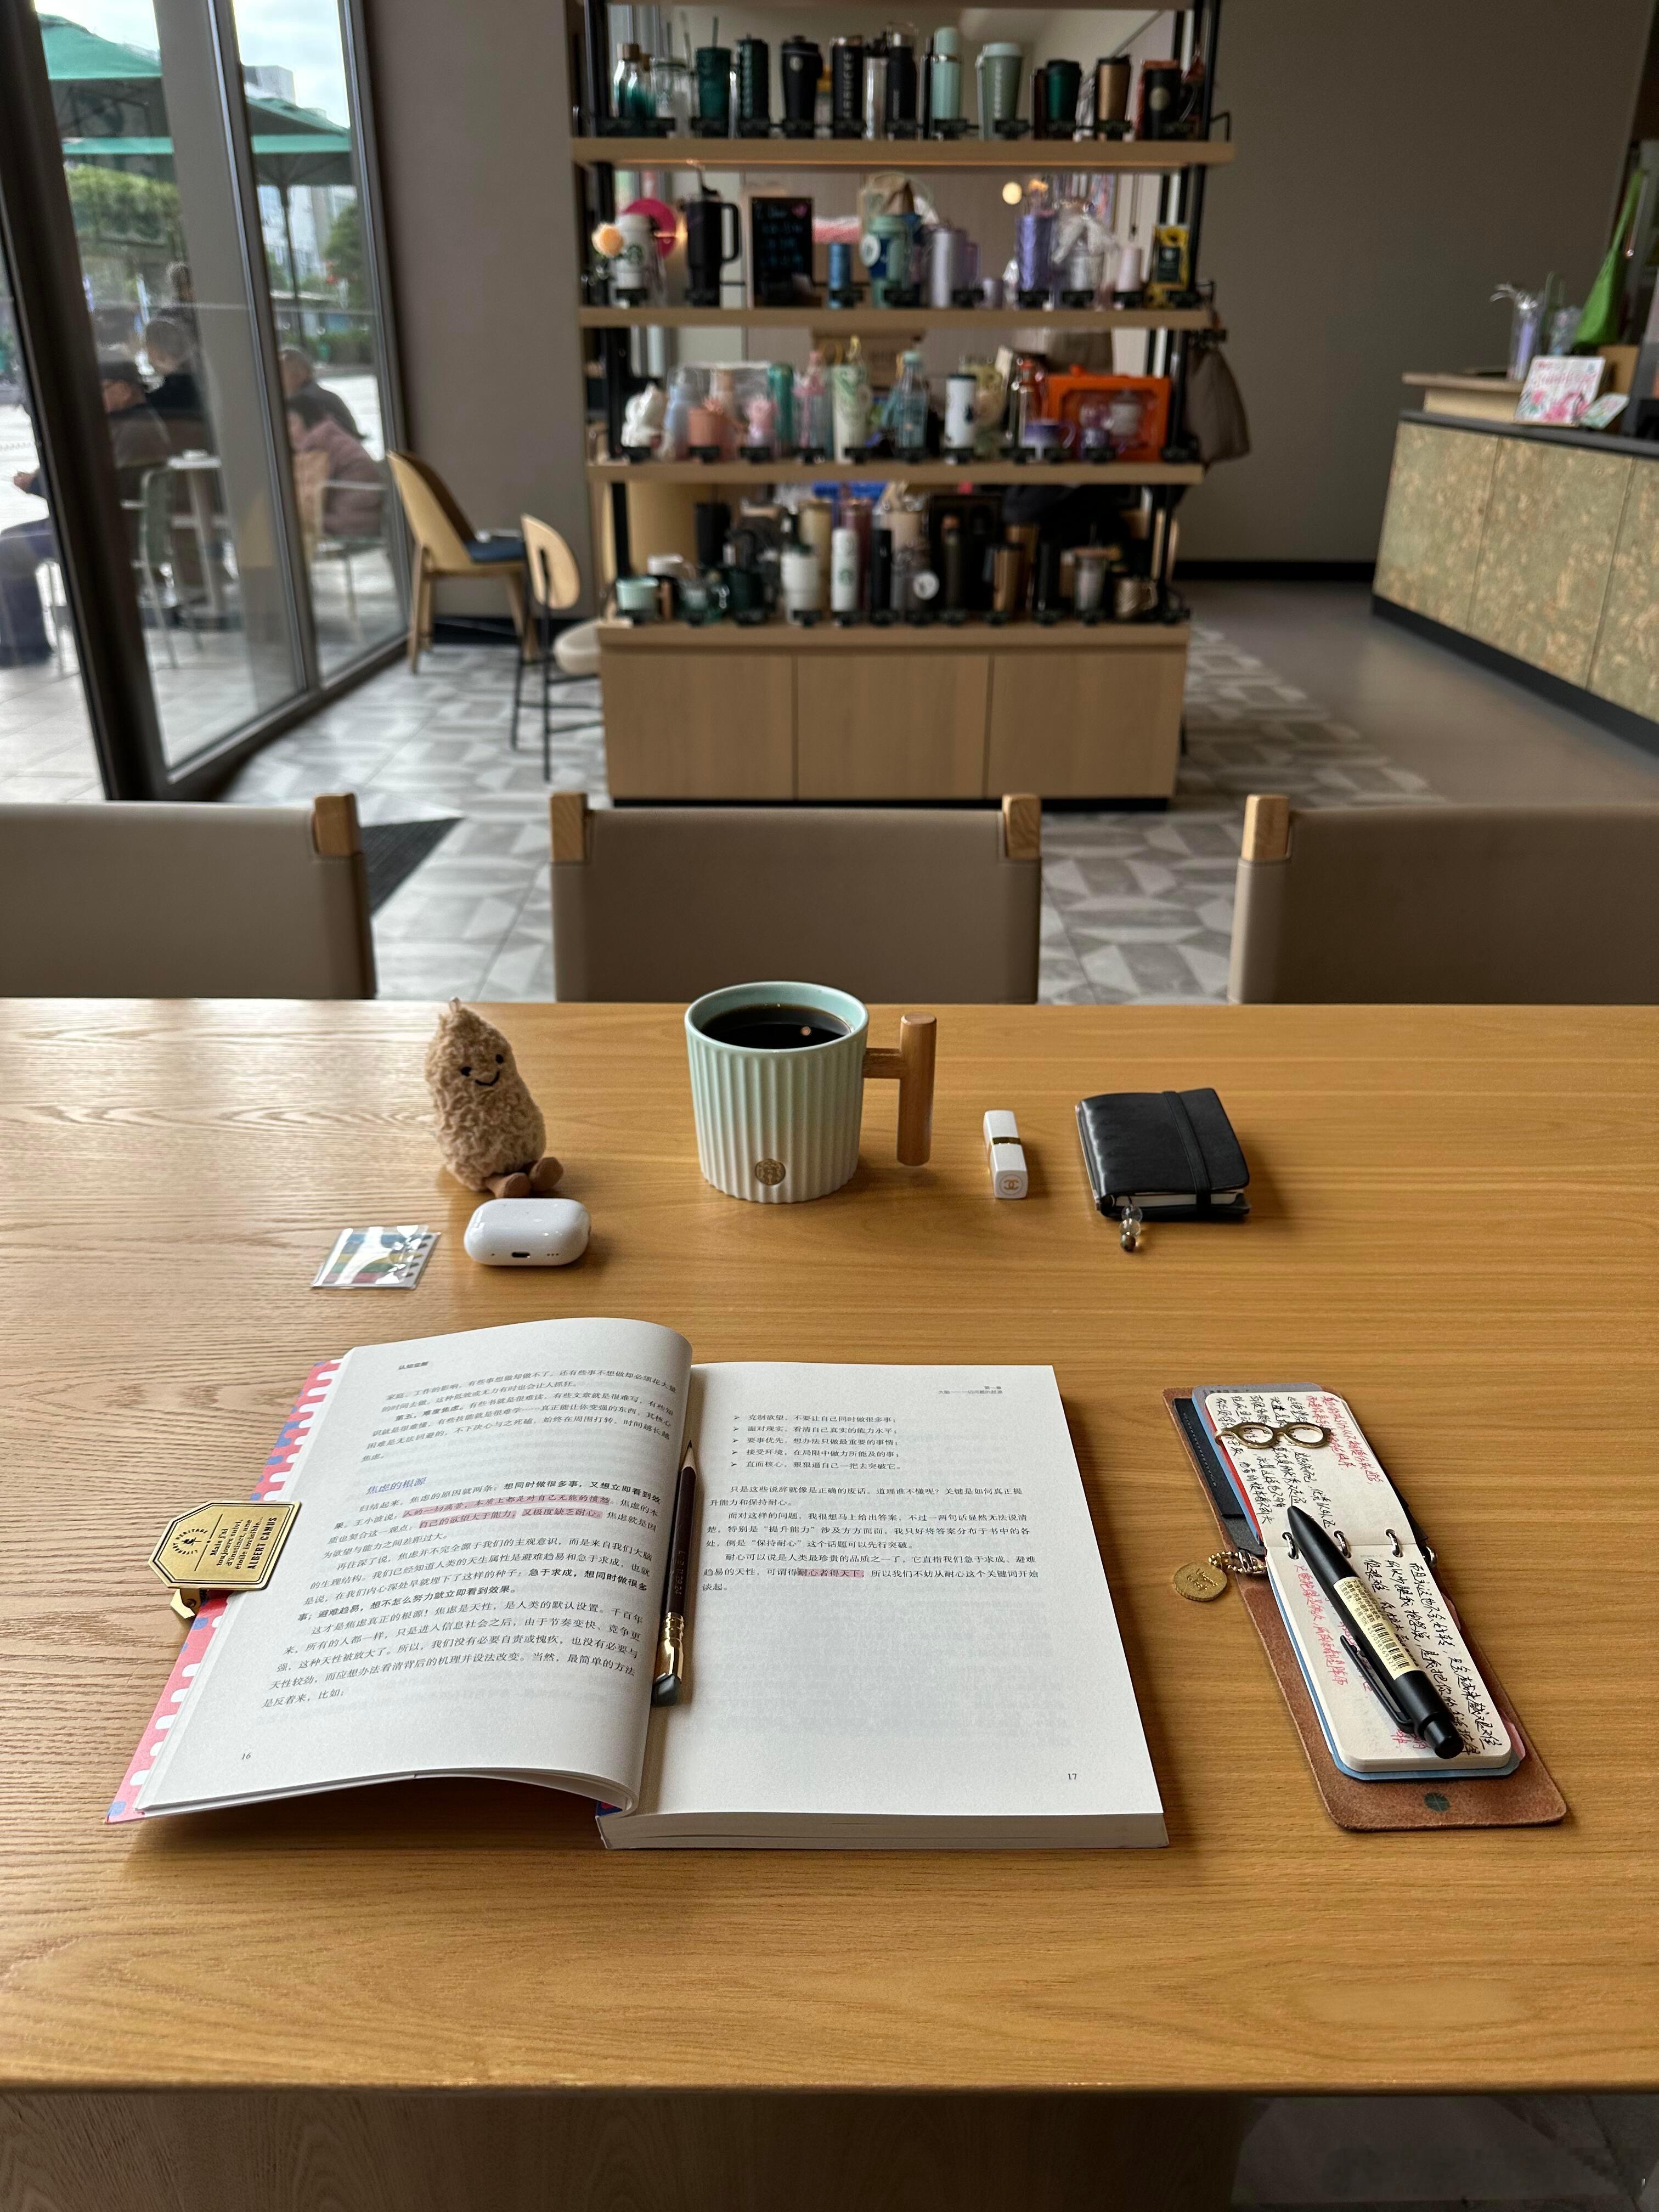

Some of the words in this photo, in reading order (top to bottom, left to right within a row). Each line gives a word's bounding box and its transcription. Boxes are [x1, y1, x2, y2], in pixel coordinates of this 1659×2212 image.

[365, 1477, 427, 1495] 焦虑的根源
[247, 1543, 267, 1570] ALBERT
[260, 1517, 278, 1541] CAMUS
